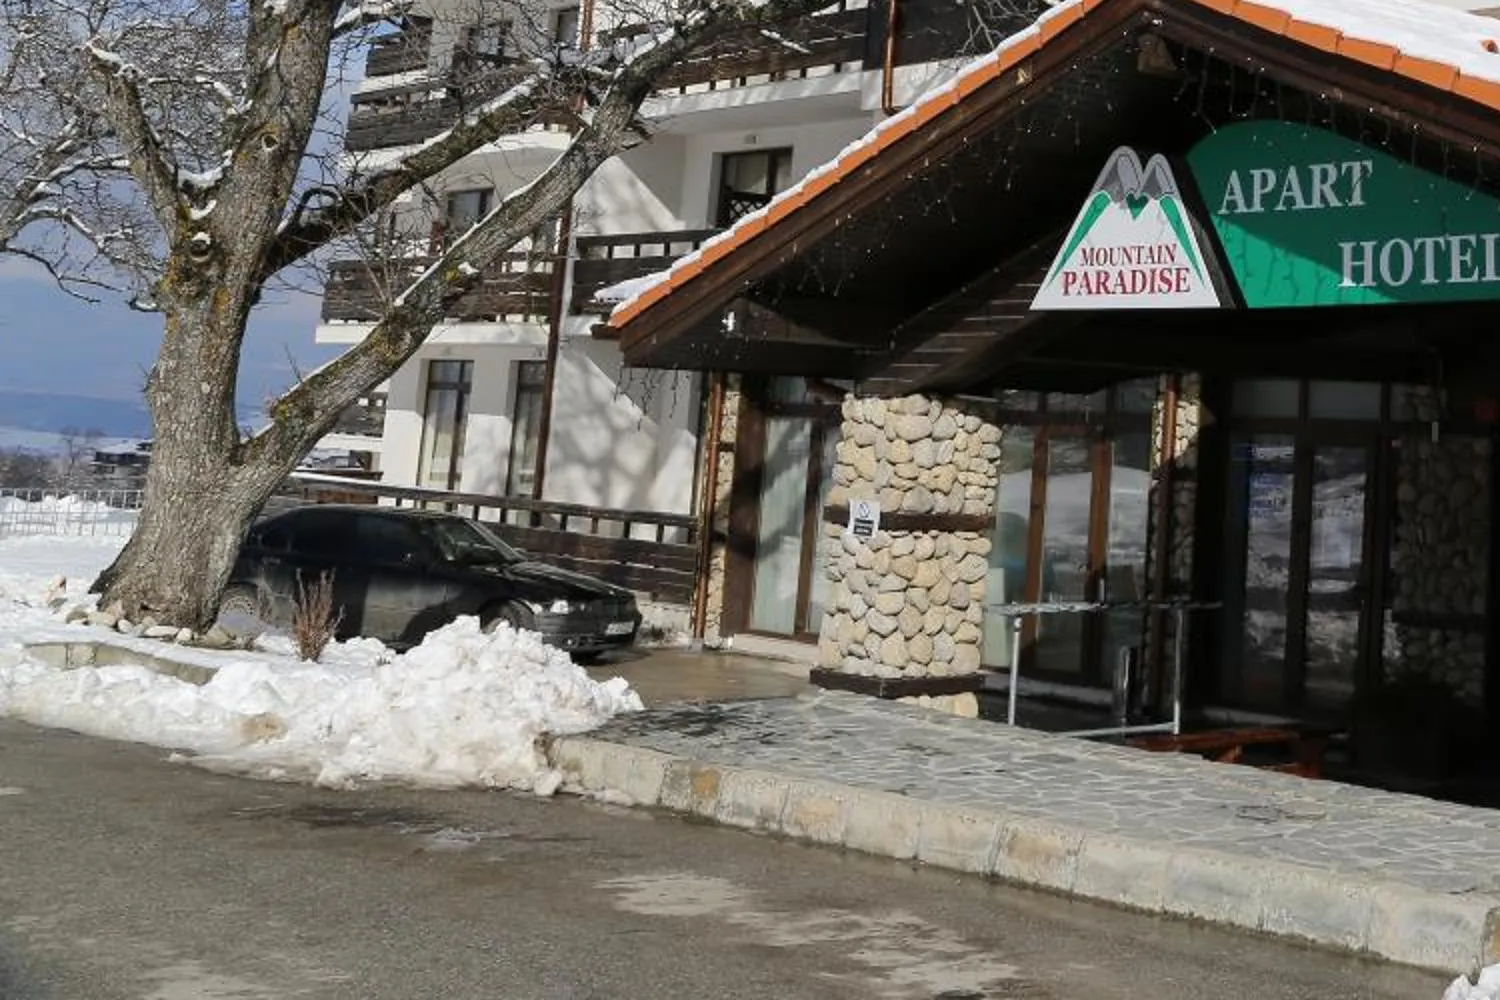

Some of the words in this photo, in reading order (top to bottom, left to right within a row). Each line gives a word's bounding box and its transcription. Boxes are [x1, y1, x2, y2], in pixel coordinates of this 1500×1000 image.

[1217, 159, 1373, 215] APART
[1079, 243, 1177, 267] MOUNTAIN
[1062, 267, 1191, 296] PARADISE
